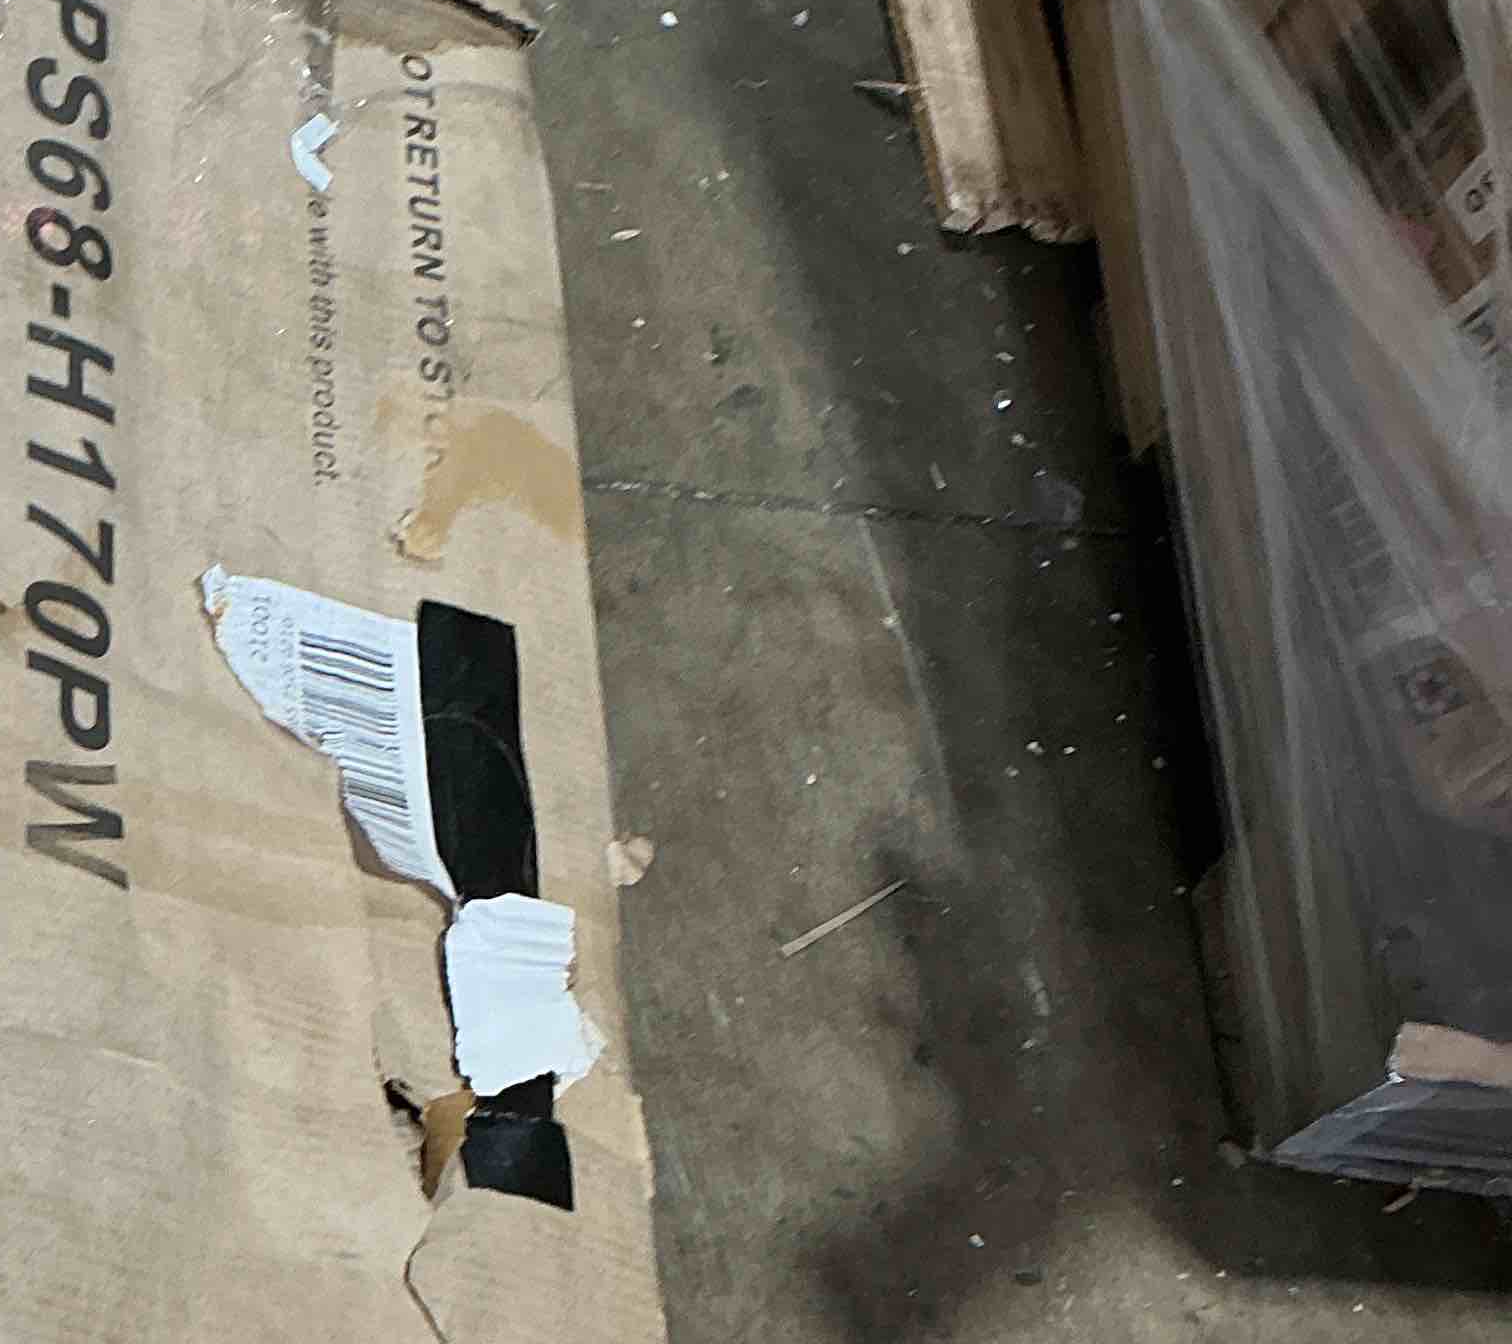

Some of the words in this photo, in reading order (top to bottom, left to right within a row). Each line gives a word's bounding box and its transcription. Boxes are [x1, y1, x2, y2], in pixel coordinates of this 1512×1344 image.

[402, 54, 436, 112] OT
[403, 114, 445, 282] RETURN
[308, 227, 337, 287] with
[308, 293, 339, 350] this
[415, 296, 450, 345] TO
[305, 355, 341, 487] product.
